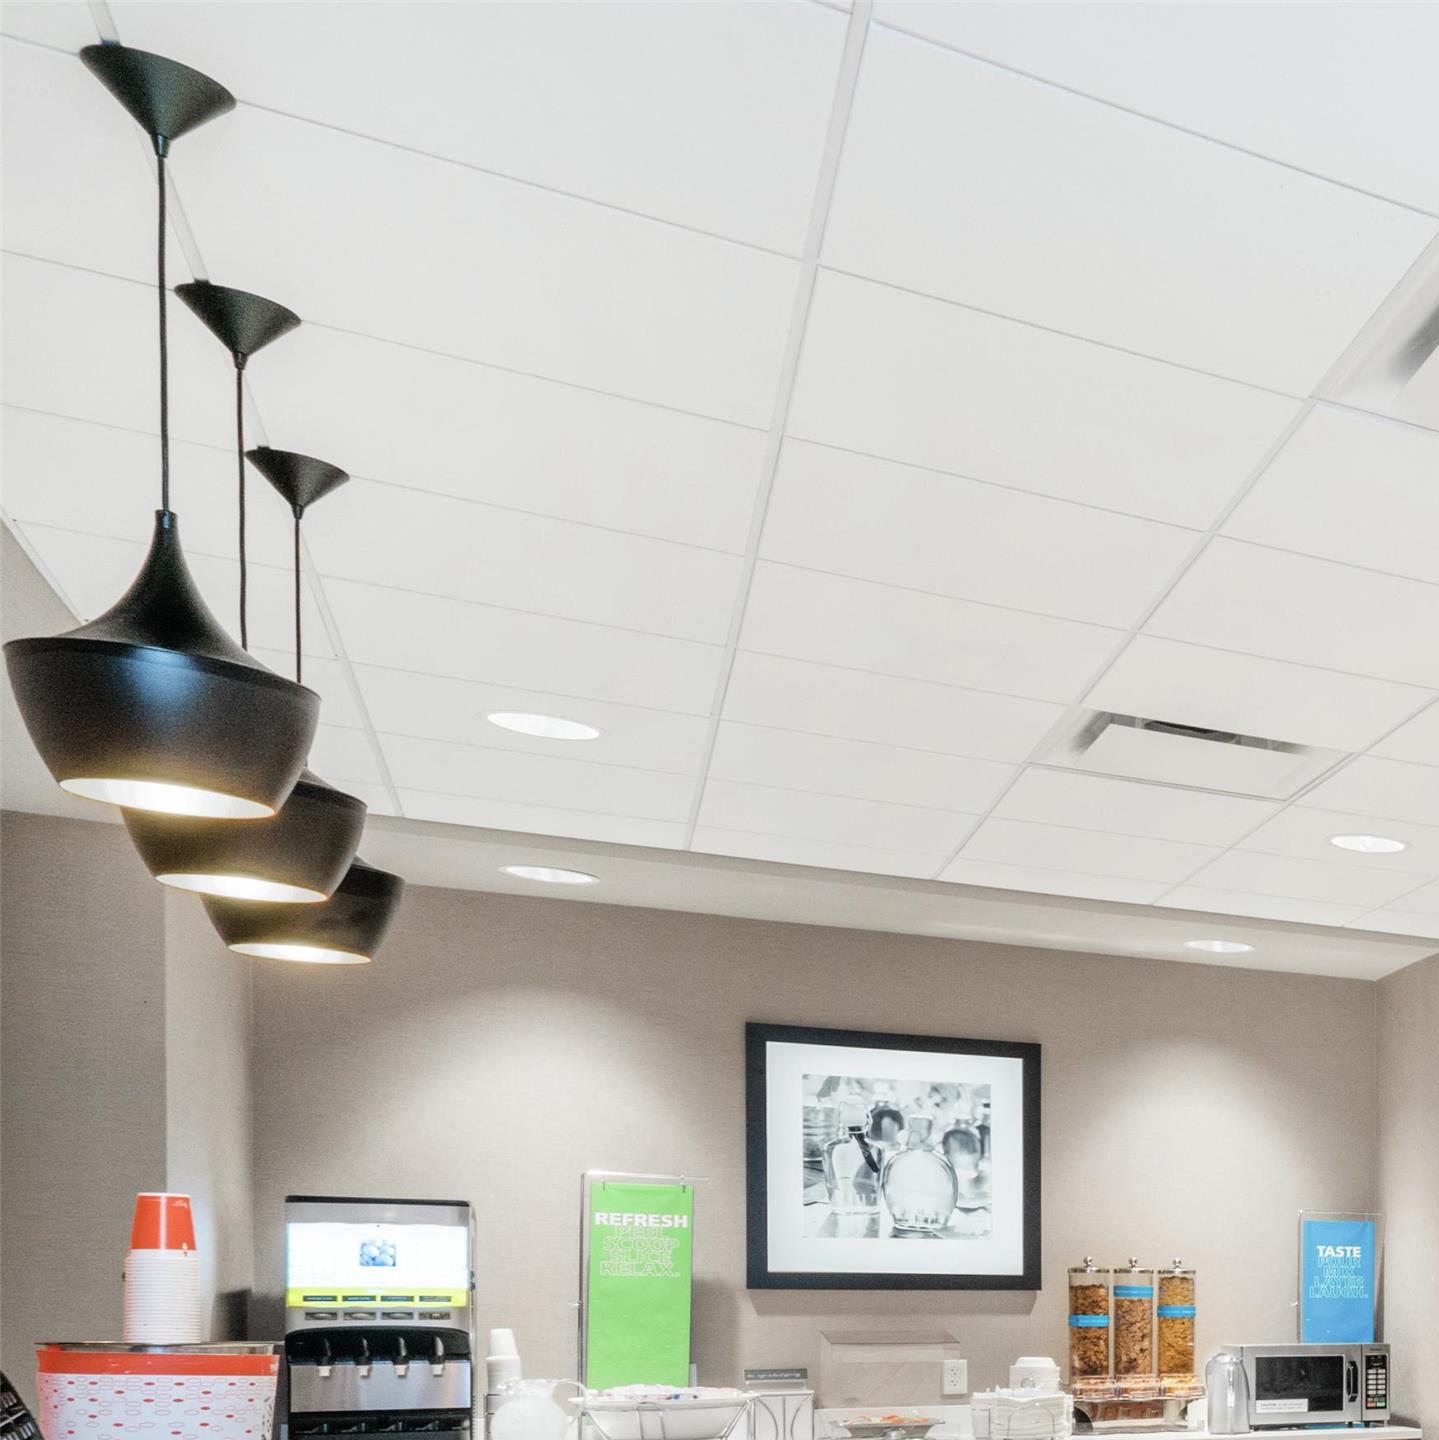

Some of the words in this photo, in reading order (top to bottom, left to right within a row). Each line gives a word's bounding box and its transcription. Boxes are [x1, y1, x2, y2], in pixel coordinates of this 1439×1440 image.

[594, 1211, 689, 1228] REFRESH
[602, 1235, 681, 1251] SCOOP
[609, 1248, 673, 1264] SLICE
[1316, 1245, 1362, 1258] TASTE
[599, 1260, 681, 1278] RELAX.
[1317, 1256, 1361, 1268] POUR
[1323, 1265, 1356, 1278] MIX
[1313, 1275, 1366, 1289] LAYER
[1309, 1285, 1369, 1299] LAUGH.
